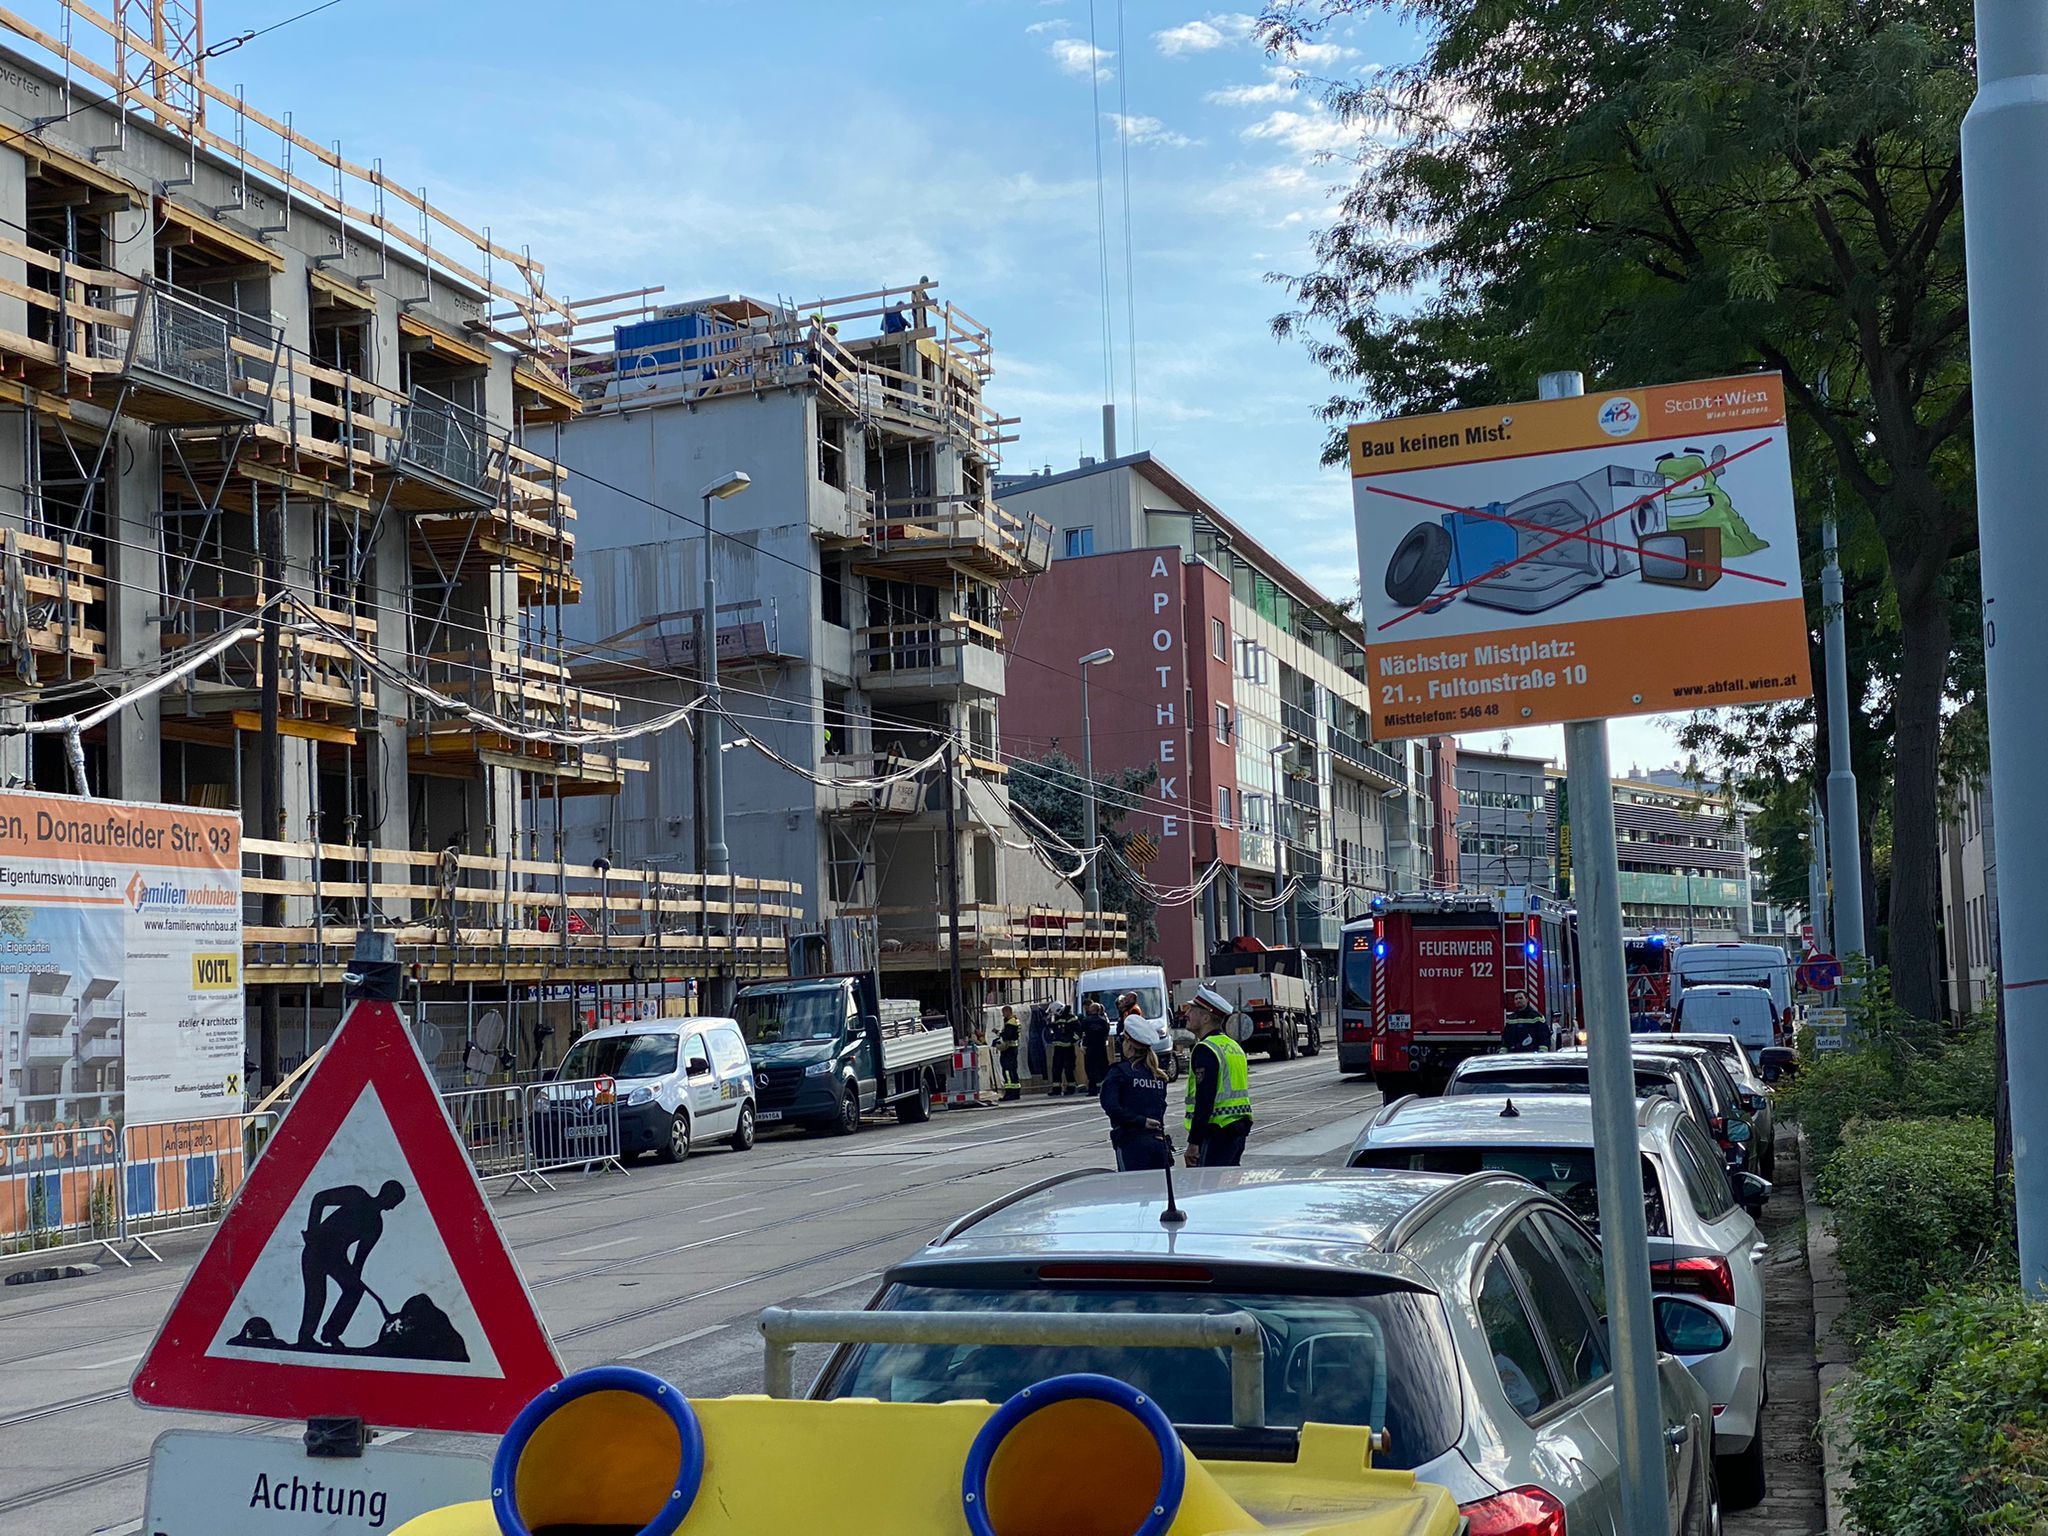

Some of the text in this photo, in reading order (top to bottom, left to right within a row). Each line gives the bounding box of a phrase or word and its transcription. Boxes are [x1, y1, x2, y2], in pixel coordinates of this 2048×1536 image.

[231, 184, 265, 209] ovrtec
[328, 234, 359, 251] ovetec
[1706, 409, 1726, 420] Wien
[1728, 408, 1739, 417] ist
[1361, 424, 1511, 458] Bau keinen Mist.
[681, 634, 730, 651] RIER
[1379, 639, 1576, 677] Nächster Mistplatz:
[1381, 664, 1588, 704] 21., Fultonstraße 10
[1673, 674, 1797, 697] www.abfall.wien.at
[1150, 556, 1180, 837] APOTHEKE
[1384, 703, 1500, 727] Misttelefon: 546 48
[37, 811, 165, 849] Donaufelder
[171, 823, 202, 852] Str.
[208, 827, 231, 854] 93
[0, 867, 117, 891] Eigentumswohnungen
[144, 919, 237, 931] www.familienwohnbau.at
[7, 941, 50, 955] Eigengärten
[1419, 941, 1494, 956] FEUERWEHR
[197, 959, 232, 983] VOITL
[1419, 962, 1494, 978] NOTRUF 122
[178, 1018, 200, 1028] atelier
[200, 1018, 205, 1026] 4
[206, 1017, 238, 1027] architects
[1817, 1039, 1841, 1048] Anfang
[164, 1139, 192, 1151] Anan
[249, 1472, 388, 1528] Achtung
